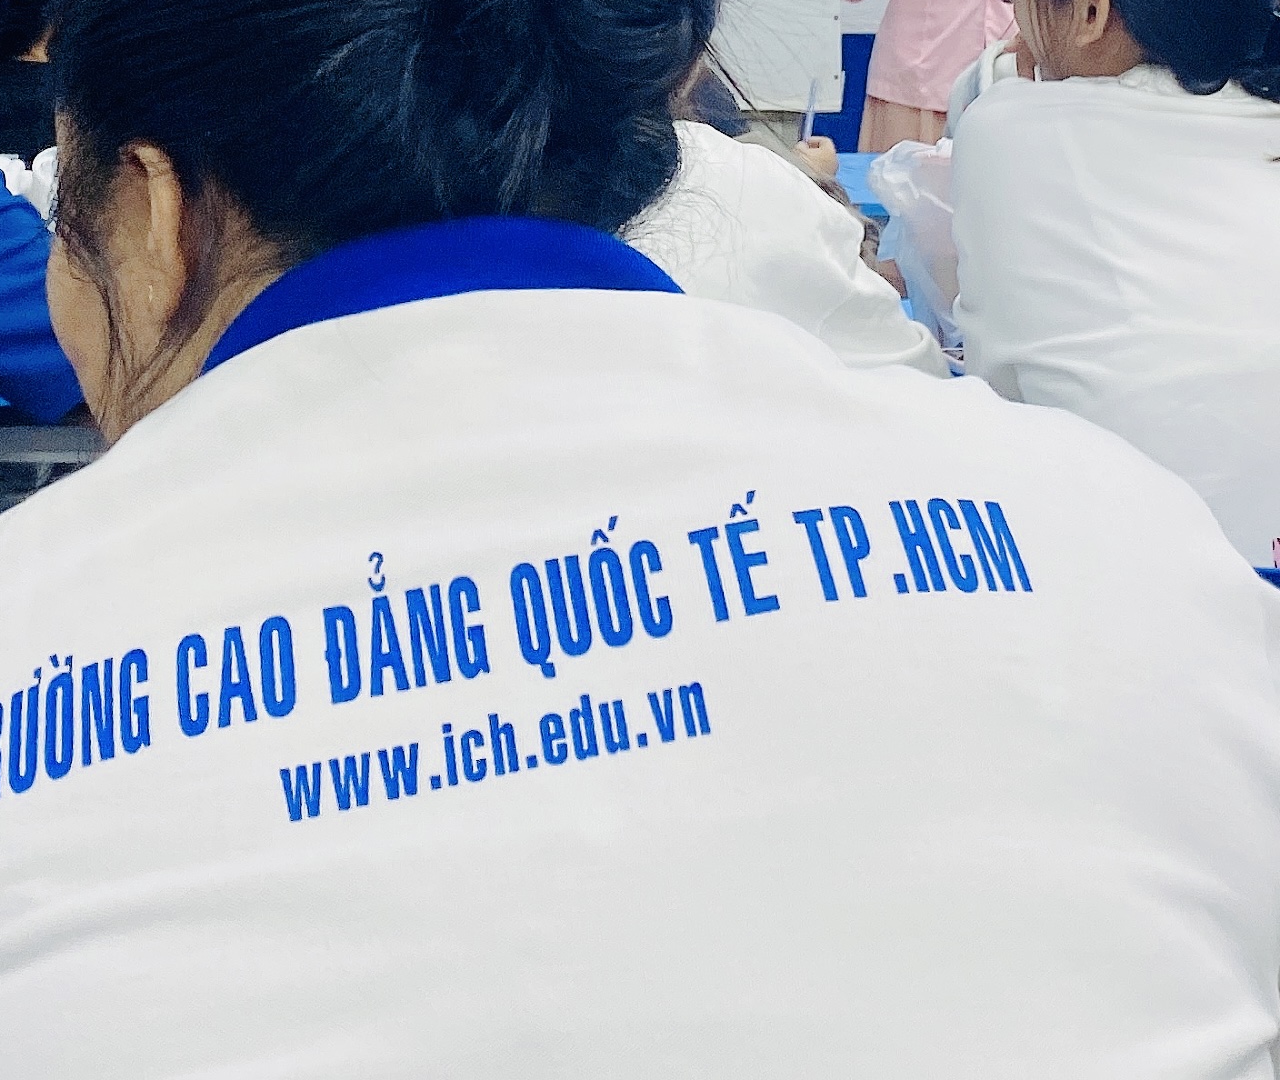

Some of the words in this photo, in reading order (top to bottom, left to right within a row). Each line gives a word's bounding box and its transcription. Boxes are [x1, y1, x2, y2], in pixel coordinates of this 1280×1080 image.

[176, 615, 297, 738] CAO
[324, 552, 491, 706] ĐẲNG
[509, 515, 673, 679] QUỐC
[687, 491, 781, 623] TẾ
[279, 681, 712, 823] www.ich.edu.vn
